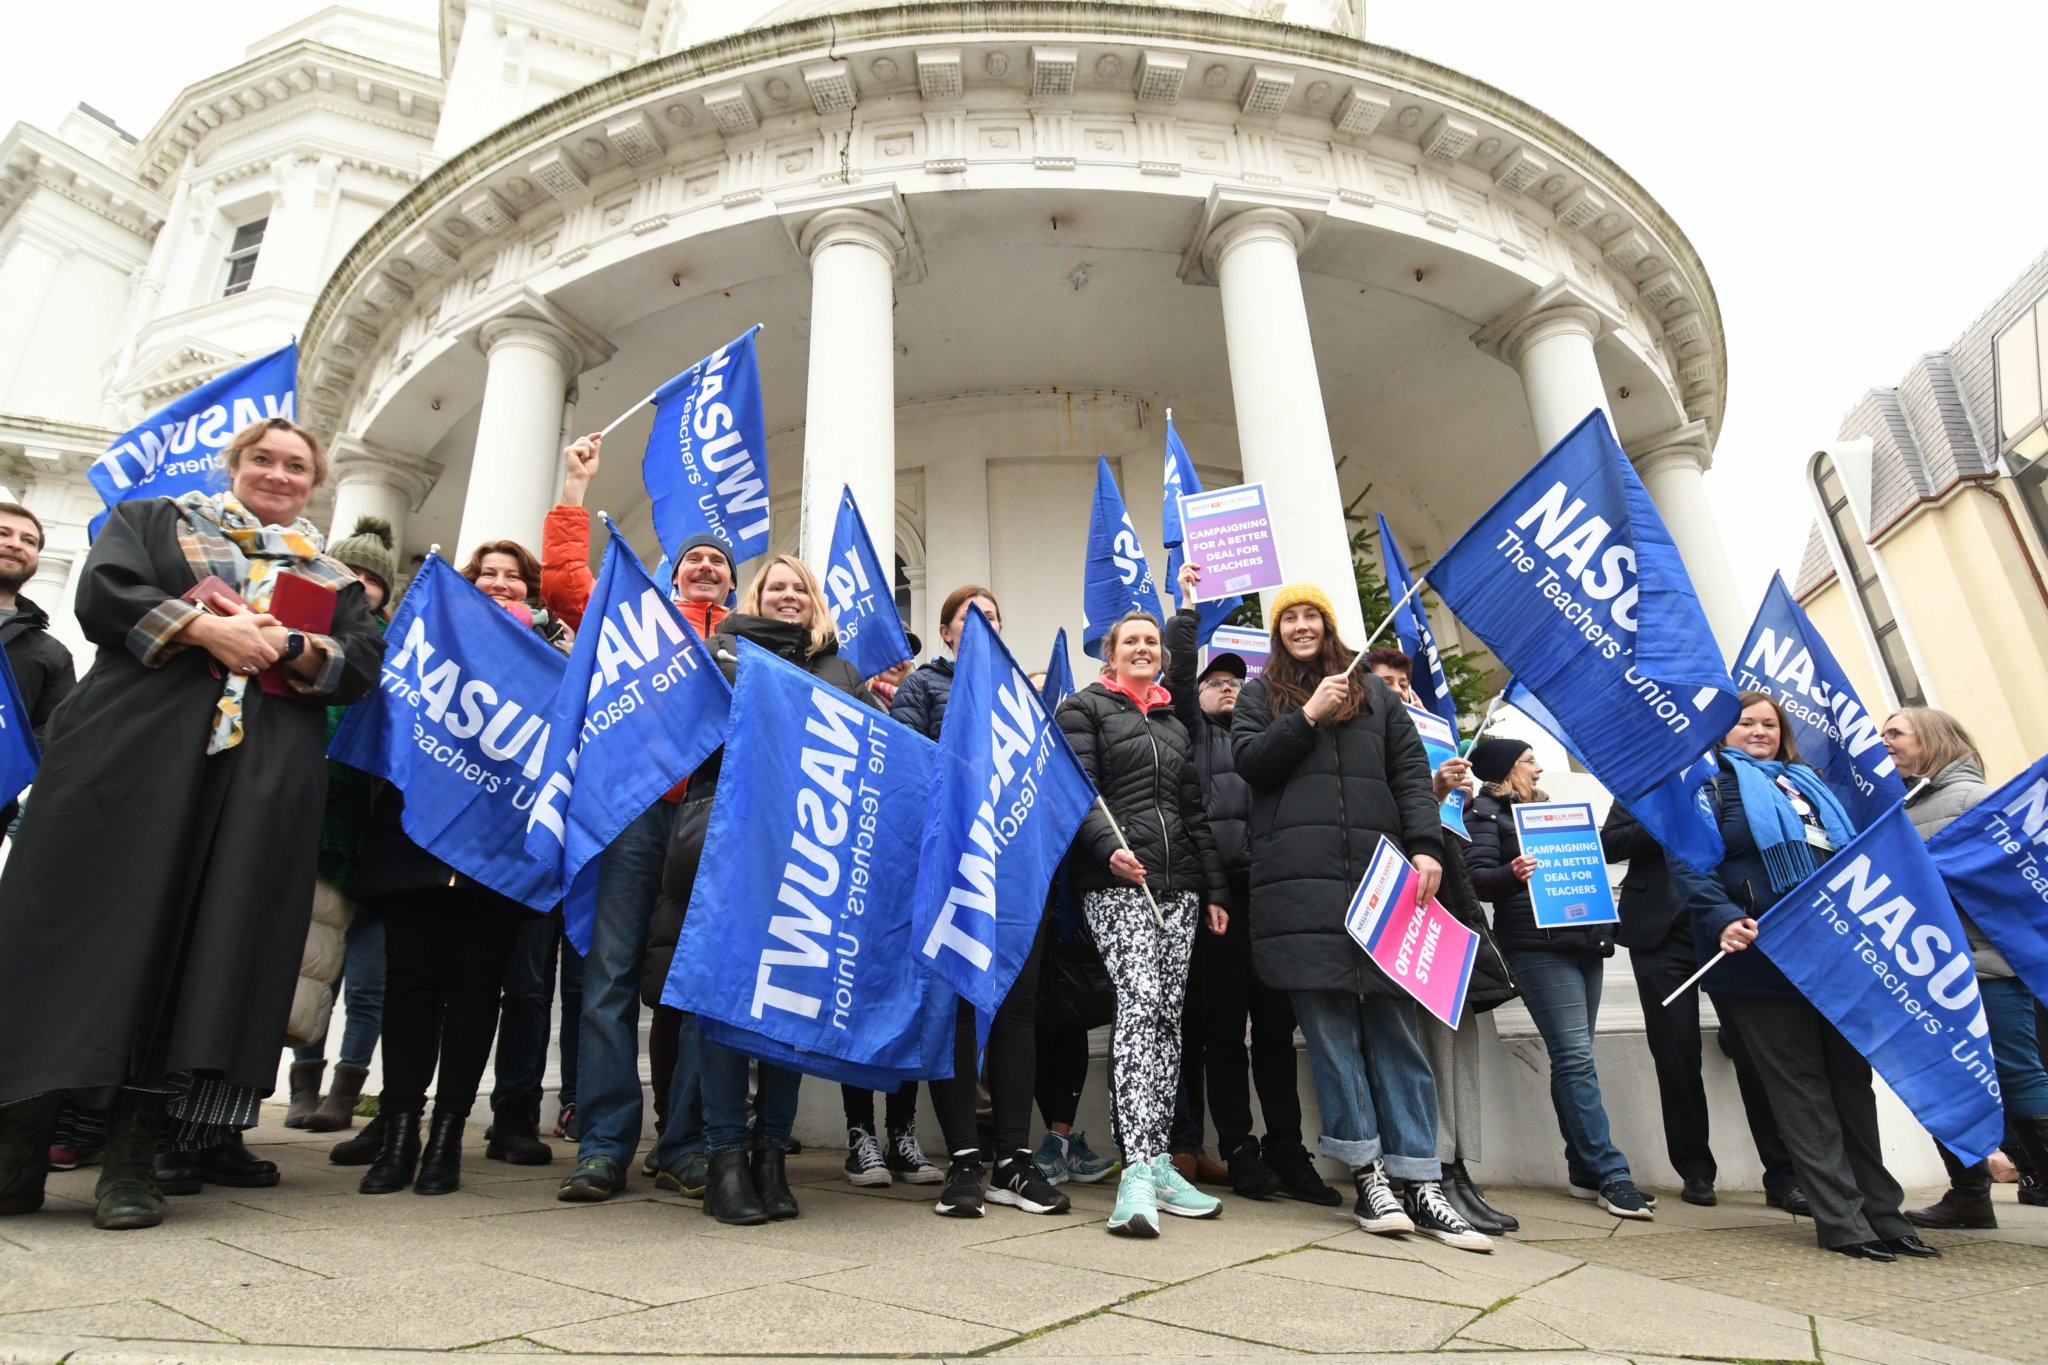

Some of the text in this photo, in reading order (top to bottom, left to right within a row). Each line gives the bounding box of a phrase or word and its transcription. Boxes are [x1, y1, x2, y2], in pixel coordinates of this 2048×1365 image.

[679, 391, 709, 487] Teachers'
[1188, 518, 1268, 541] CAMPAIGNING
[1193, 530, 1268, 552] FOR A BETTER
[1206, 544, 1260, 562] DEAL FOR
[1206, 556, 1264, 575] TEACHERS
[1496, 529, 1690, 735] The Teachers' Union
[380, 668, 421, 708] The
[390, 616, 552, 781] NASU
[1738, 669, 1771, 696] The
[1773, 689, 1846, 750] Teachers
[413, 721, 511, 793] eachers'
[1526, 842, 1598, 855] CAMPAIGNING
[1983, 814, 2021, 855] The
[1537, 856, 1600, 869] OR A BETTER
[1544, 871, 1592, 882] DEAL FOR
[1545, 885, 1597, 897] TEACHERS
[1415, 917, 1442, 985] STRIKE
[1826, 853, 1990, 1038] NASU
[1811, 890, 2003, 1104] The Teachers' Unio
